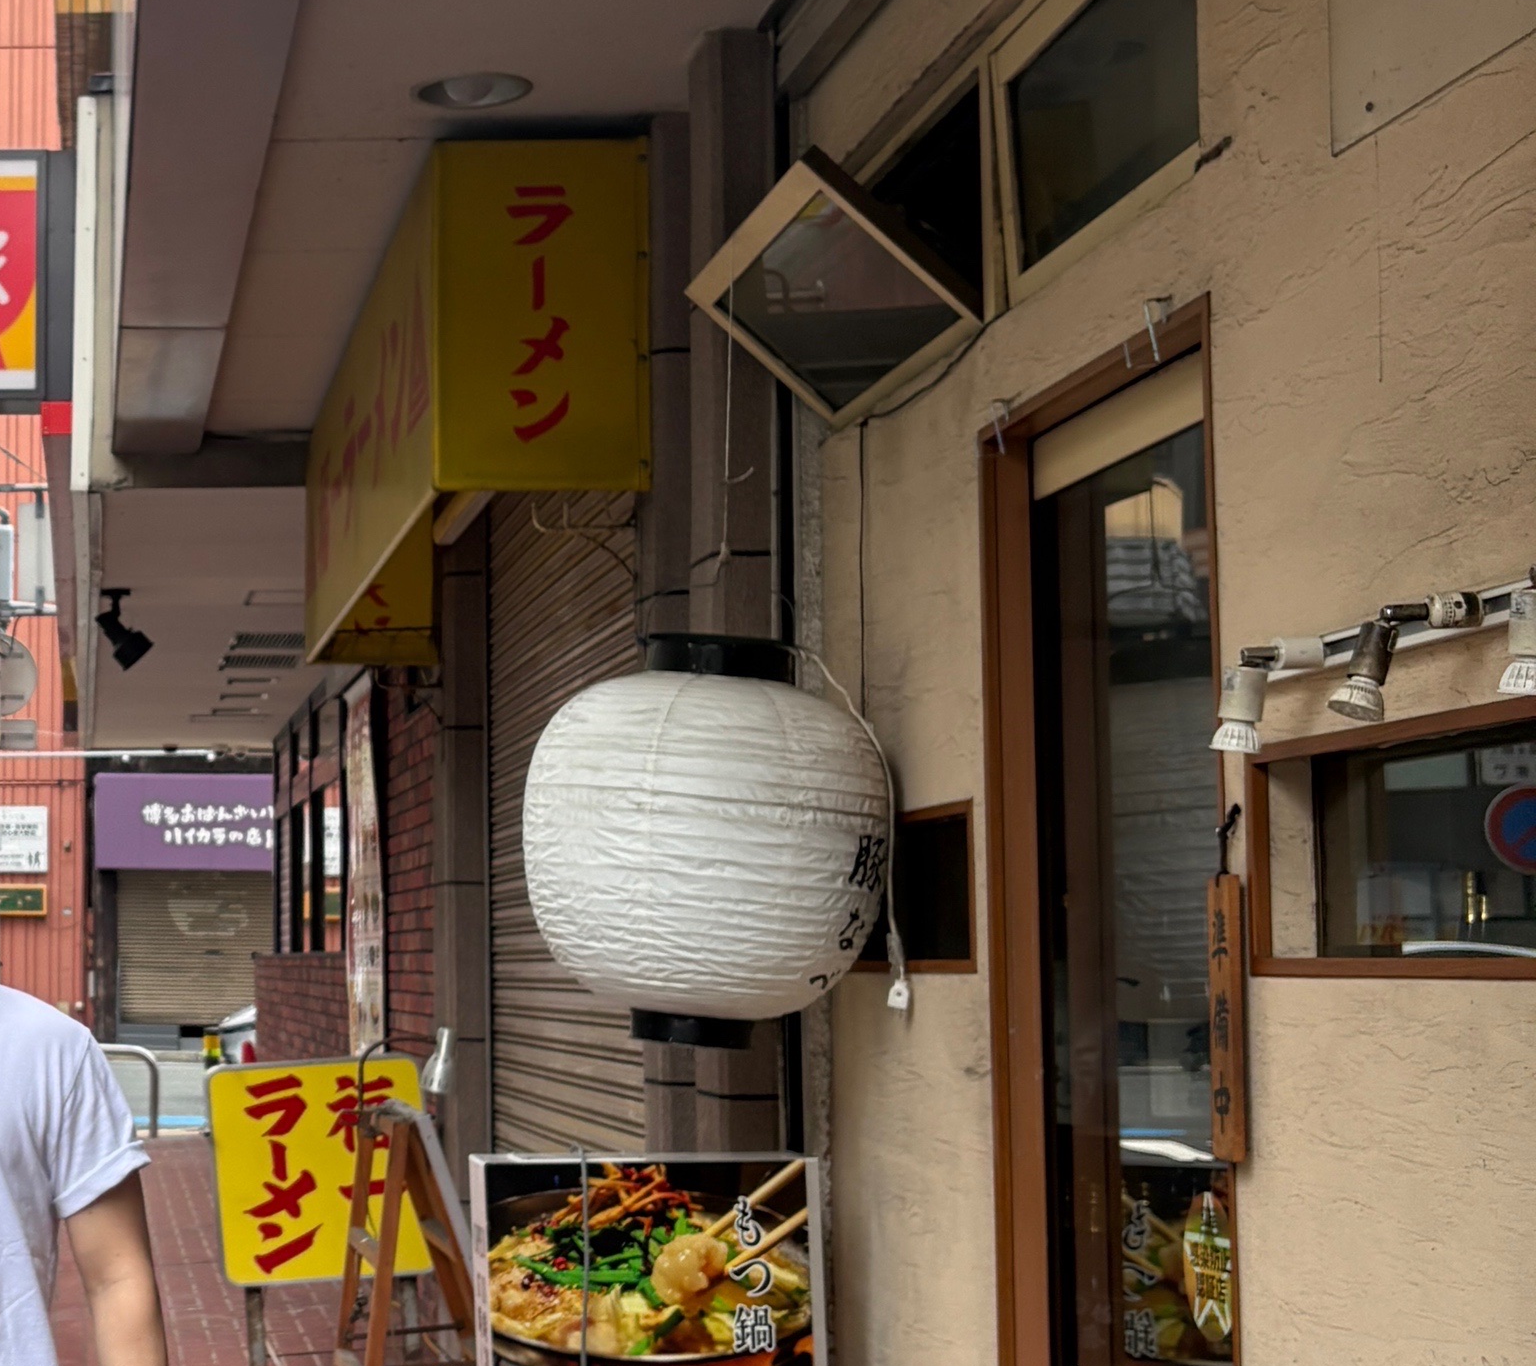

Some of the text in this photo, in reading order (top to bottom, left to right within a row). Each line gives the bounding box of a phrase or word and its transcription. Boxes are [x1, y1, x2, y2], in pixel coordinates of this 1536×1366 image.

[506, 186, 574, 444] ラーメン
[242, 1073, 325, 1275] ラーメン
[728, 1195, 777, 1354] もつ鍋
